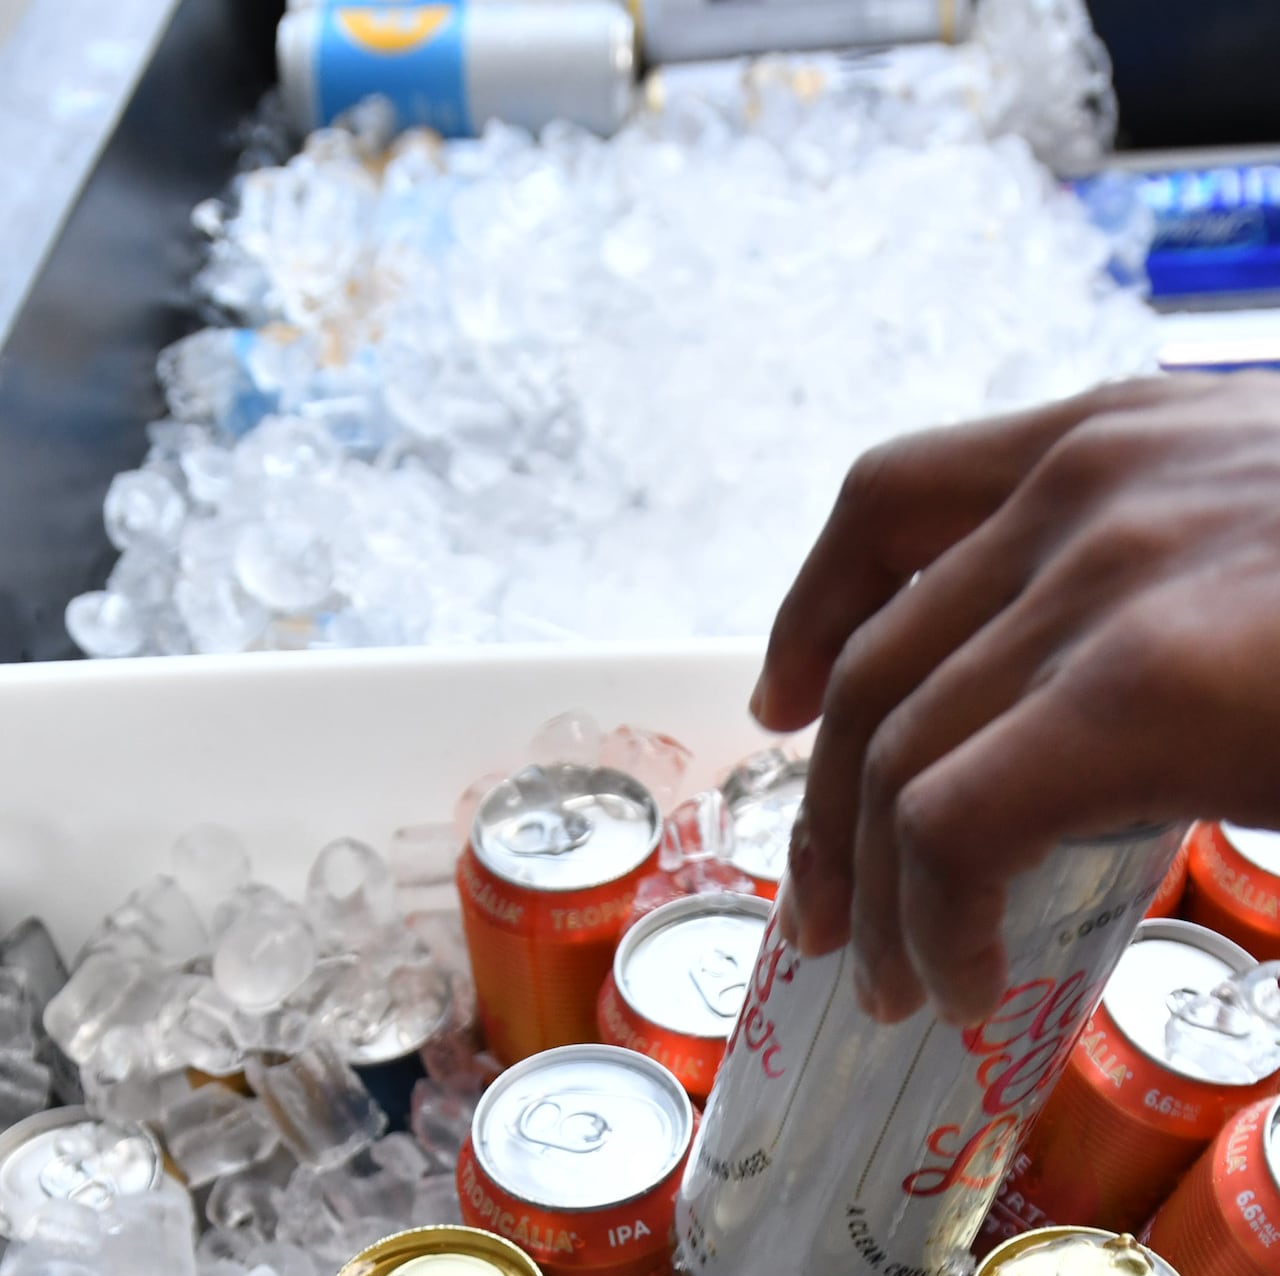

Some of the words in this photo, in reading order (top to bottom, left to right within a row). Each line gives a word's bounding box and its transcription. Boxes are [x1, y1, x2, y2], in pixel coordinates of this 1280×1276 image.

[1144, 1088, 1175, 1114] 6.6
[1236, 1189, 1261, 1222] 6.6
[608, 1219, 652, 1248] IPA
